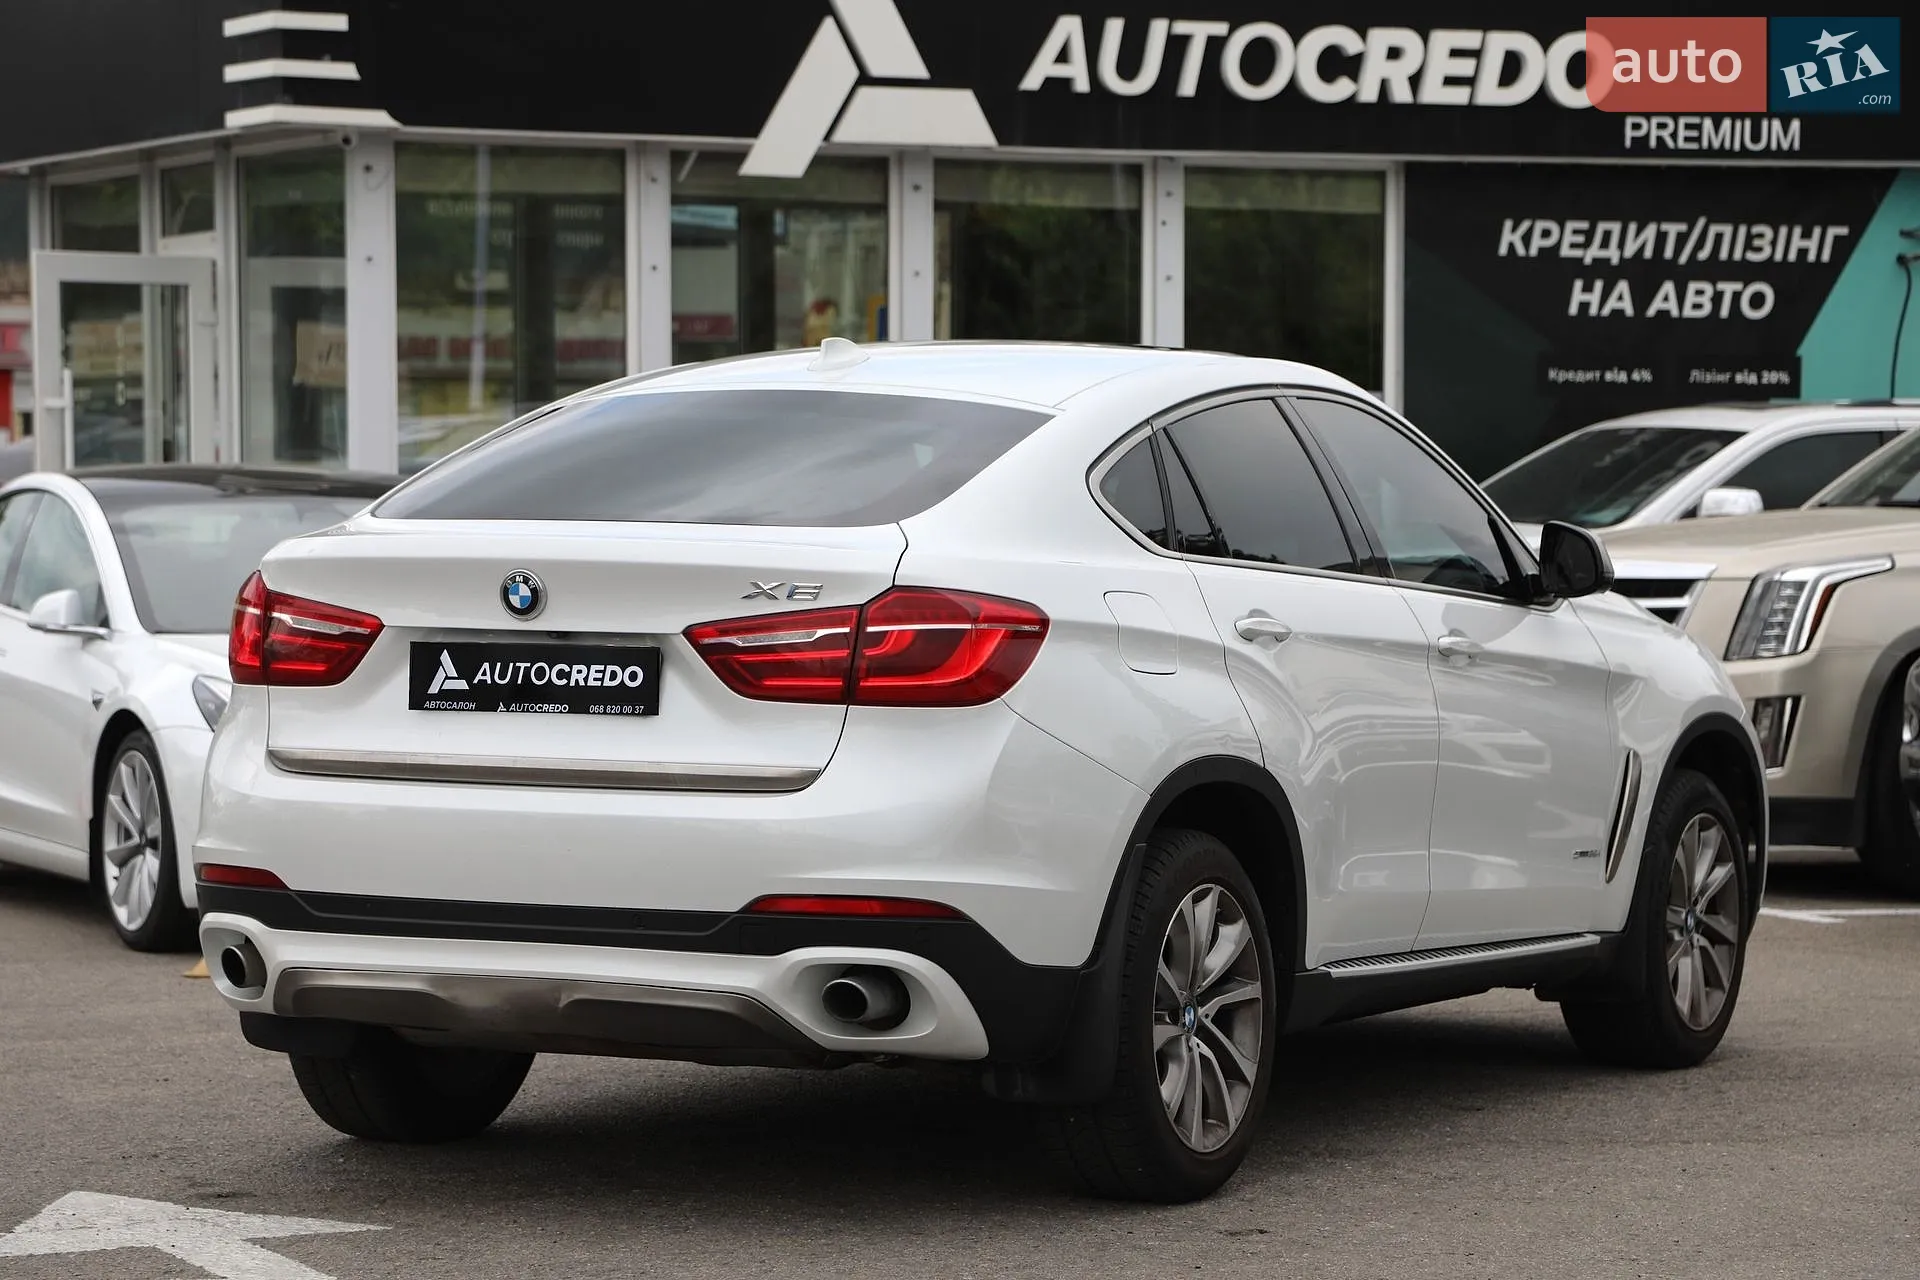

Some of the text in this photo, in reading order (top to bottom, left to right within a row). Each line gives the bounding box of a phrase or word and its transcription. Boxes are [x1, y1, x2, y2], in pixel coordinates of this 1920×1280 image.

[1018, 14, 1613, 109] AUTOCREDO
[1624, 116, 1801, 152] PREMIUM
[1497, 216, 1850, 266] КРЕДИТ/ЛІЗІНГ
[1567, 278, 1776, 321] НА АВТО
[1548, 366, 1600, 384] Кредит
[1604, 366, 1628, 384] від
[740, 580, 824, 601] X6
[473, 661, 644, 688] AUTOCREDO
[423, 700, 476, 710] АВТОСАЛОН
[509, 702, 569, 713] AUTOCREDO
[589, 704, 645, 714] 068 820 00 37
